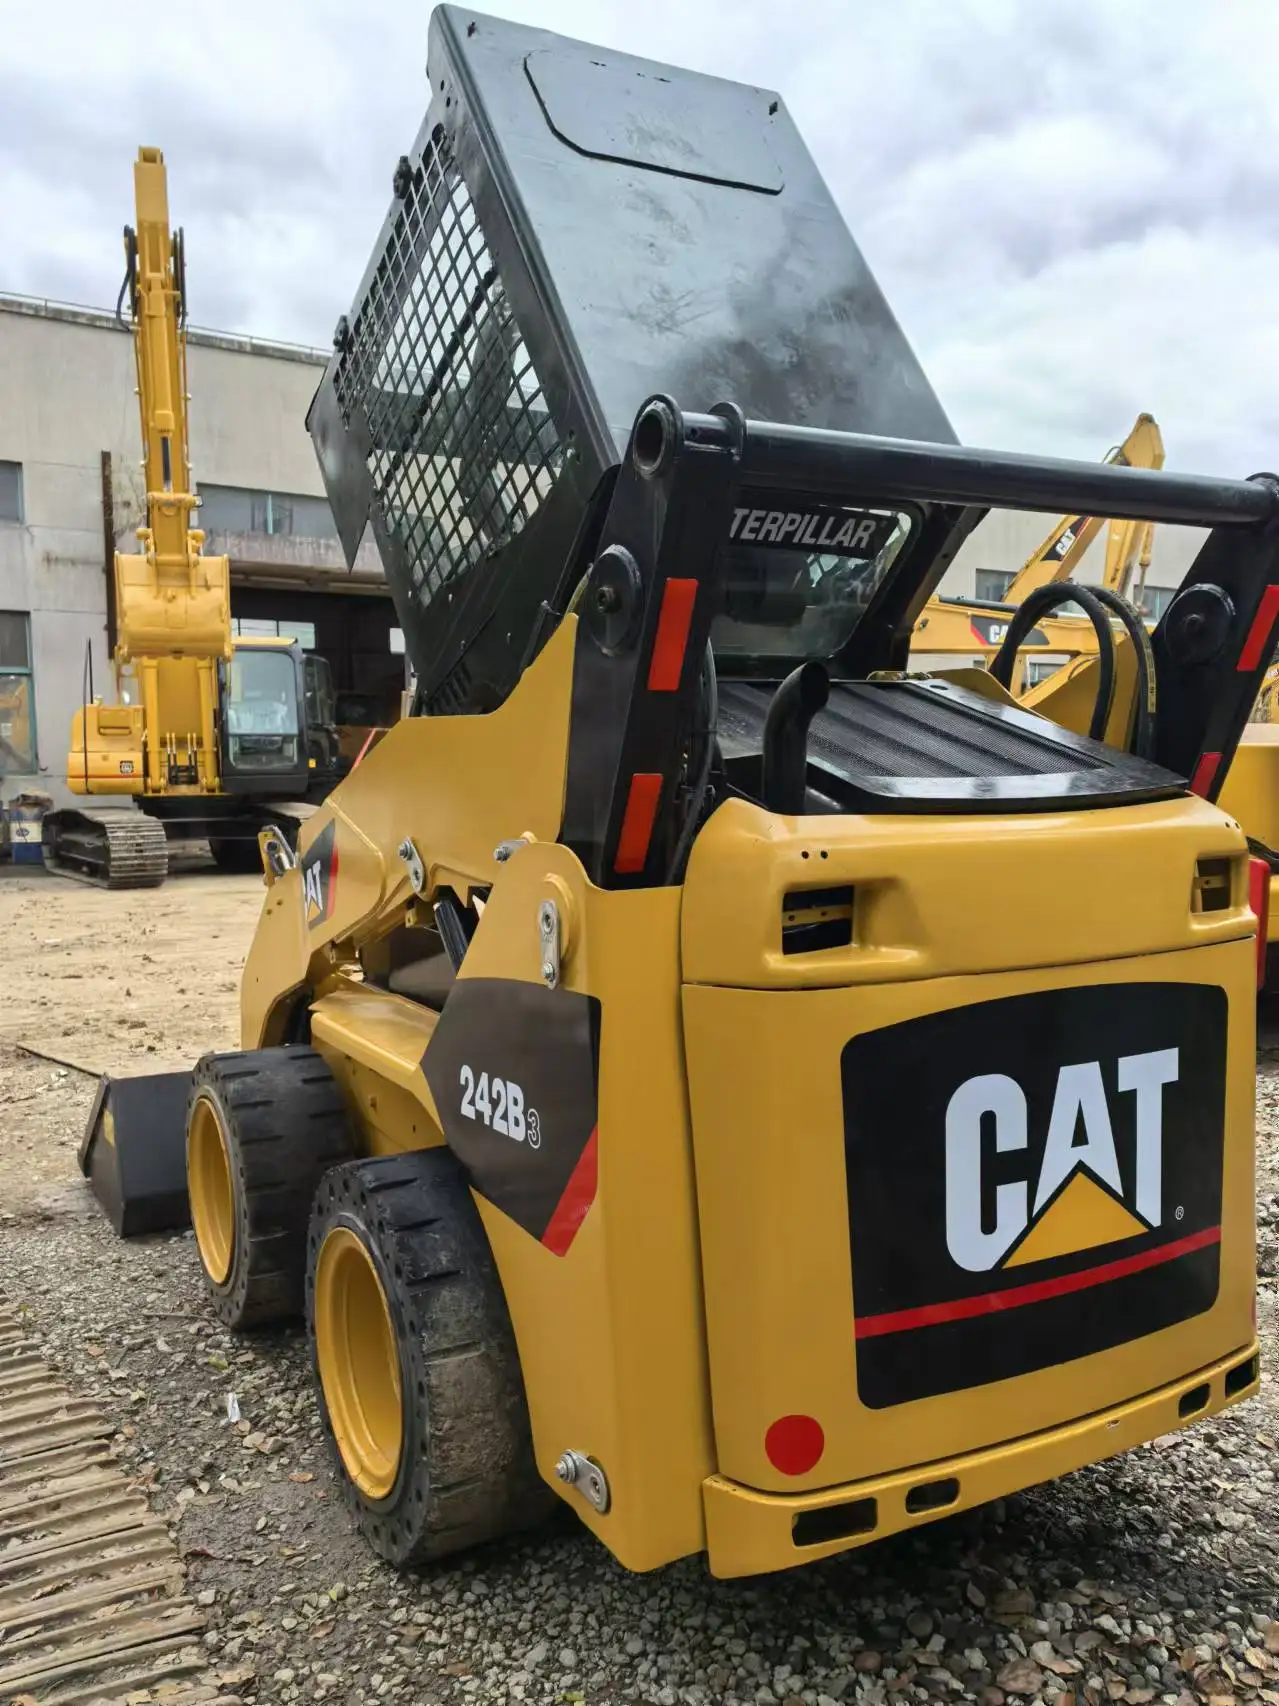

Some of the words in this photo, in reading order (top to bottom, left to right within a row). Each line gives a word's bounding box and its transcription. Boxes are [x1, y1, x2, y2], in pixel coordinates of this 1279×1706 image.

[729, 508, 876, 548] TERPILLAR
[989, 625, 1009, 643] CA
[303, 860, 323, 921] AT
[945, 1047, 1179, 1272] CAT
